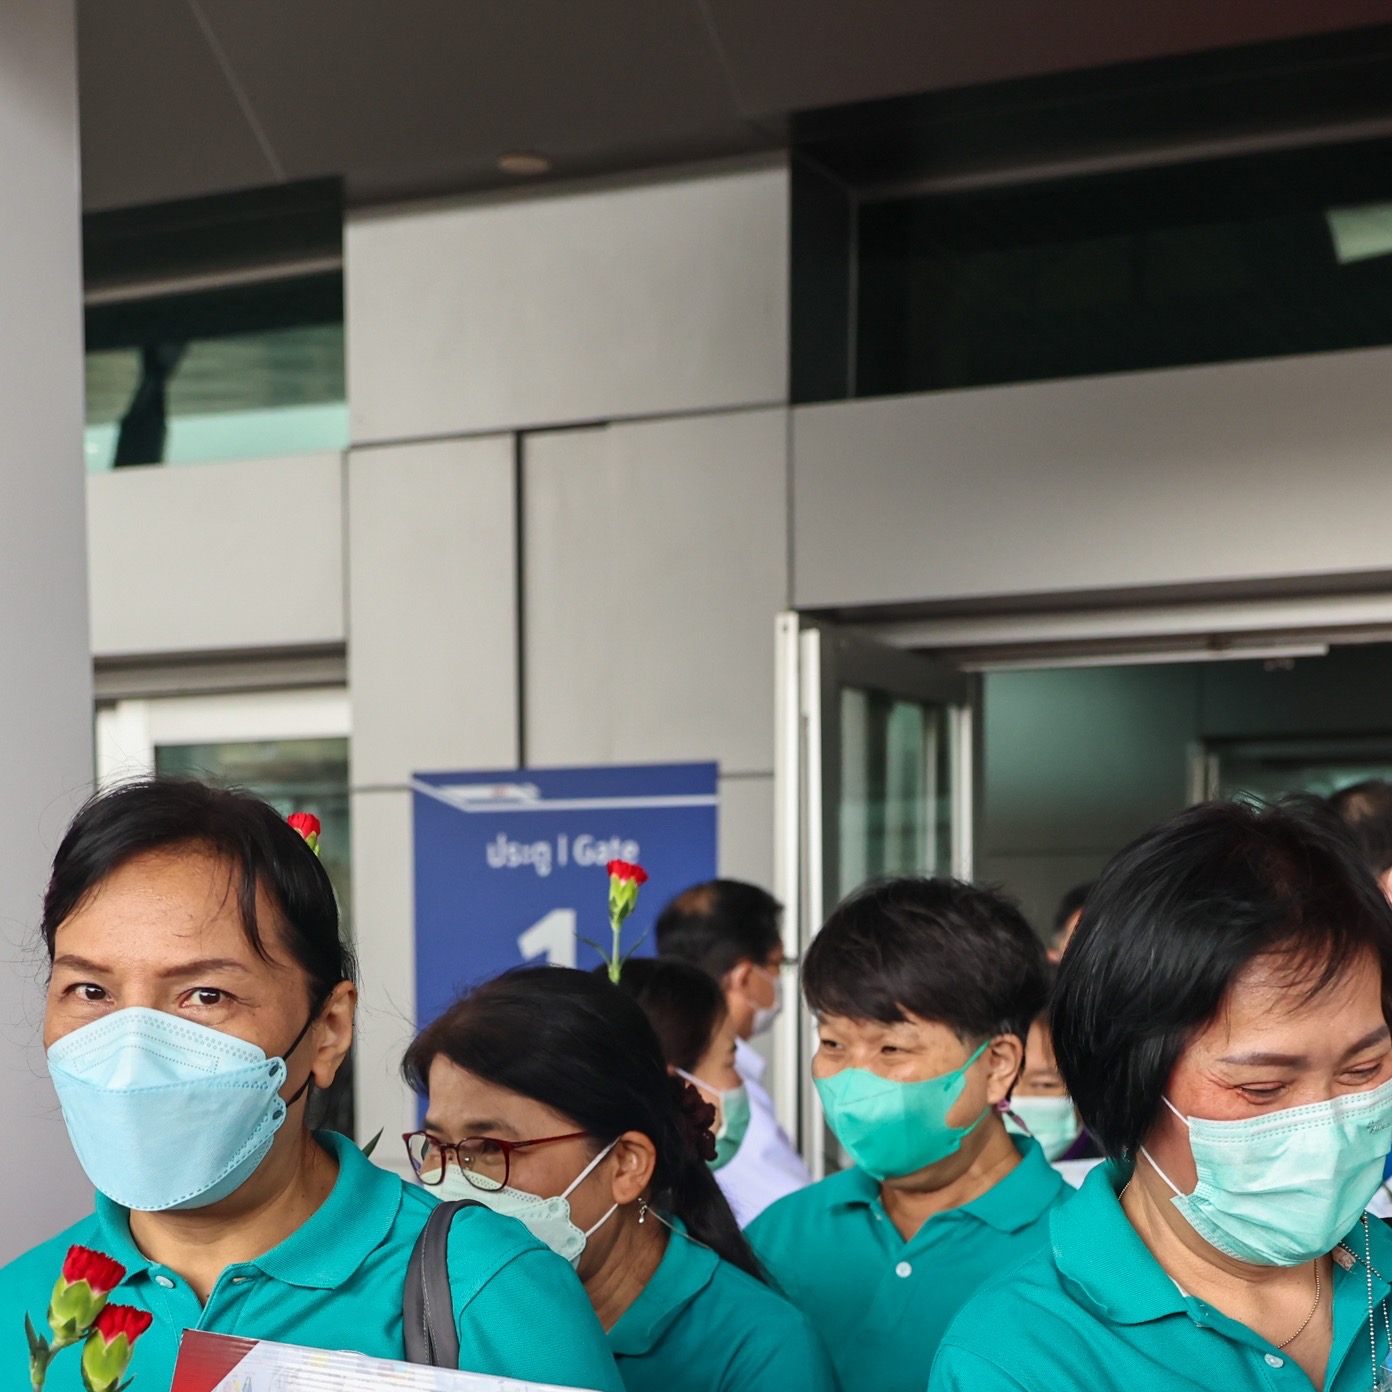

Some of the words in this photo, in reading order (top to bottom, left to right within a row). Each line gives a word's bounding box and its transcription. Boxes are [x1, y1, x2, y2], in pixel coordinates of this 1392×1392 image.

[486, 832, 552, 878] ประตู
[573, 833, 640, 867] Gate
[517, 907, 577, 969] 1
